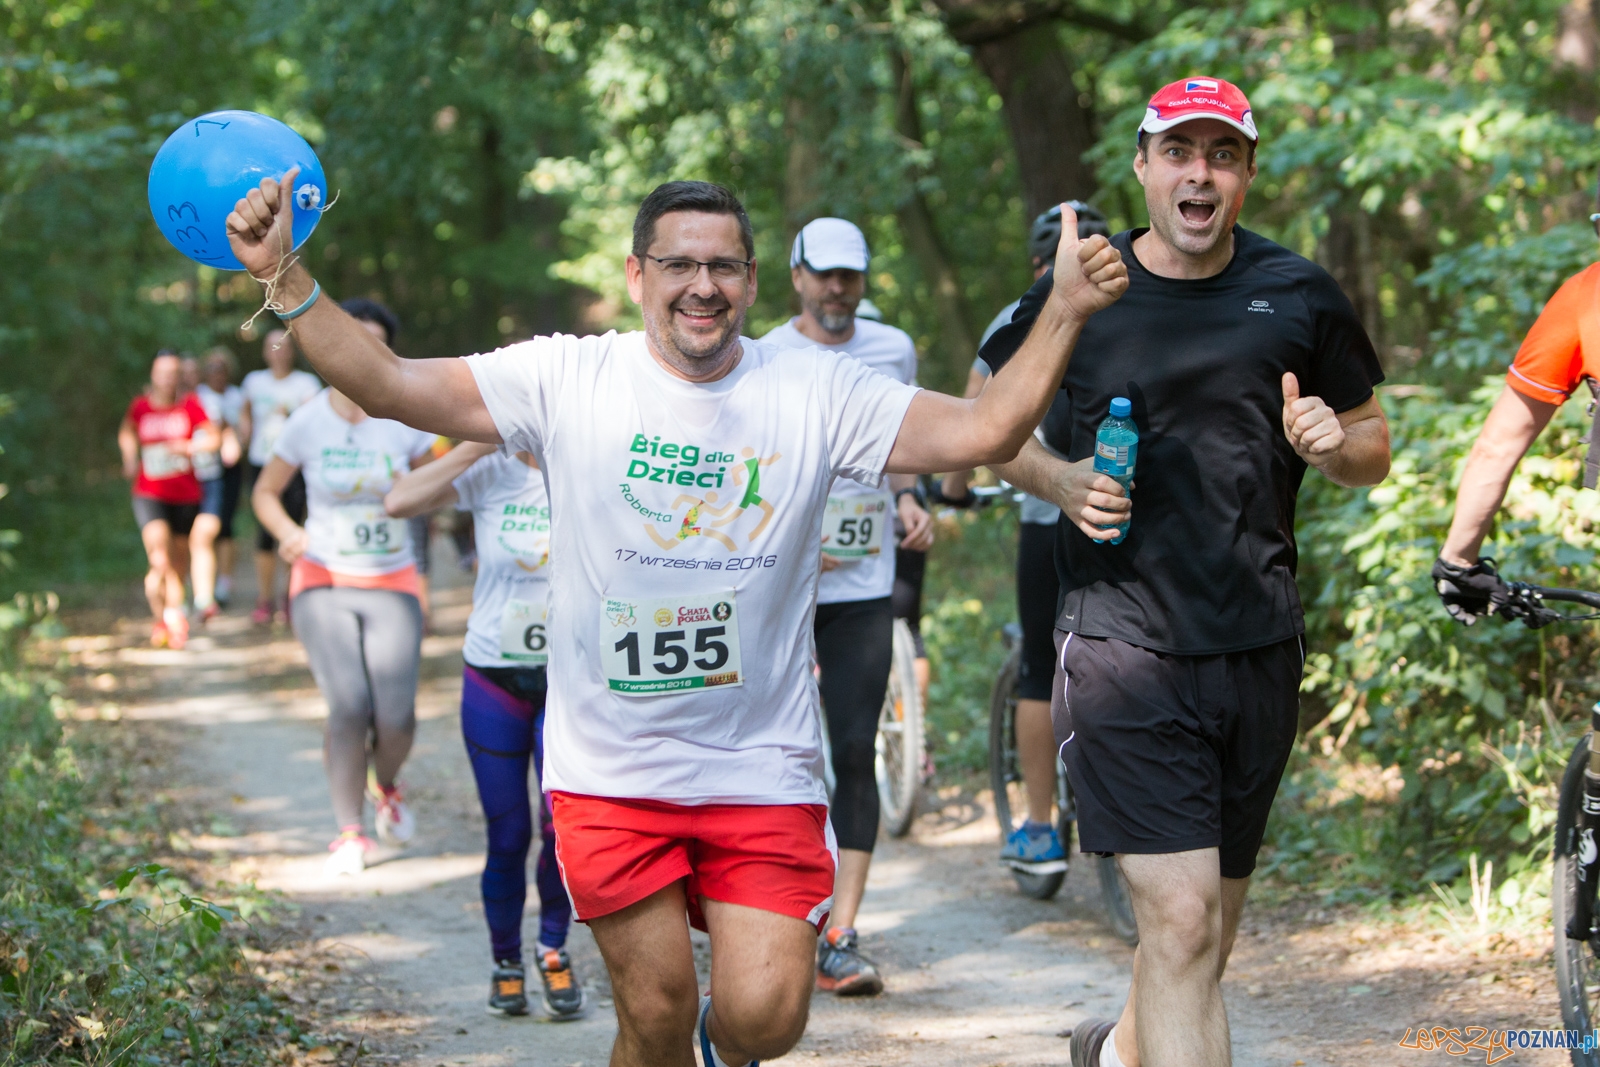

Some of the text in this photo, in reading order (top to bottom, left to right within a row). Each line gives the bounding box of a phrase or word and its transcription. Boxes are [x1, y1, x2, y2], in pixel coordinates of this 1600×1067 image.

[630, 433, 735, 467] Bieg dla
[626, 459, 726, 489] Dzieci
[619, 482, 672, 523] Roberta
[354, 523, 389, 546] 95
[501, 519, 549, 532] Dzie
[836, 517, 873, 546] 59
[614, 548, 777, 571] 17 września 2016
[677, 614, 712, 626] POLSKA
[523, 624, 547, 651] 6
[615, 626, 729, 676] 155
